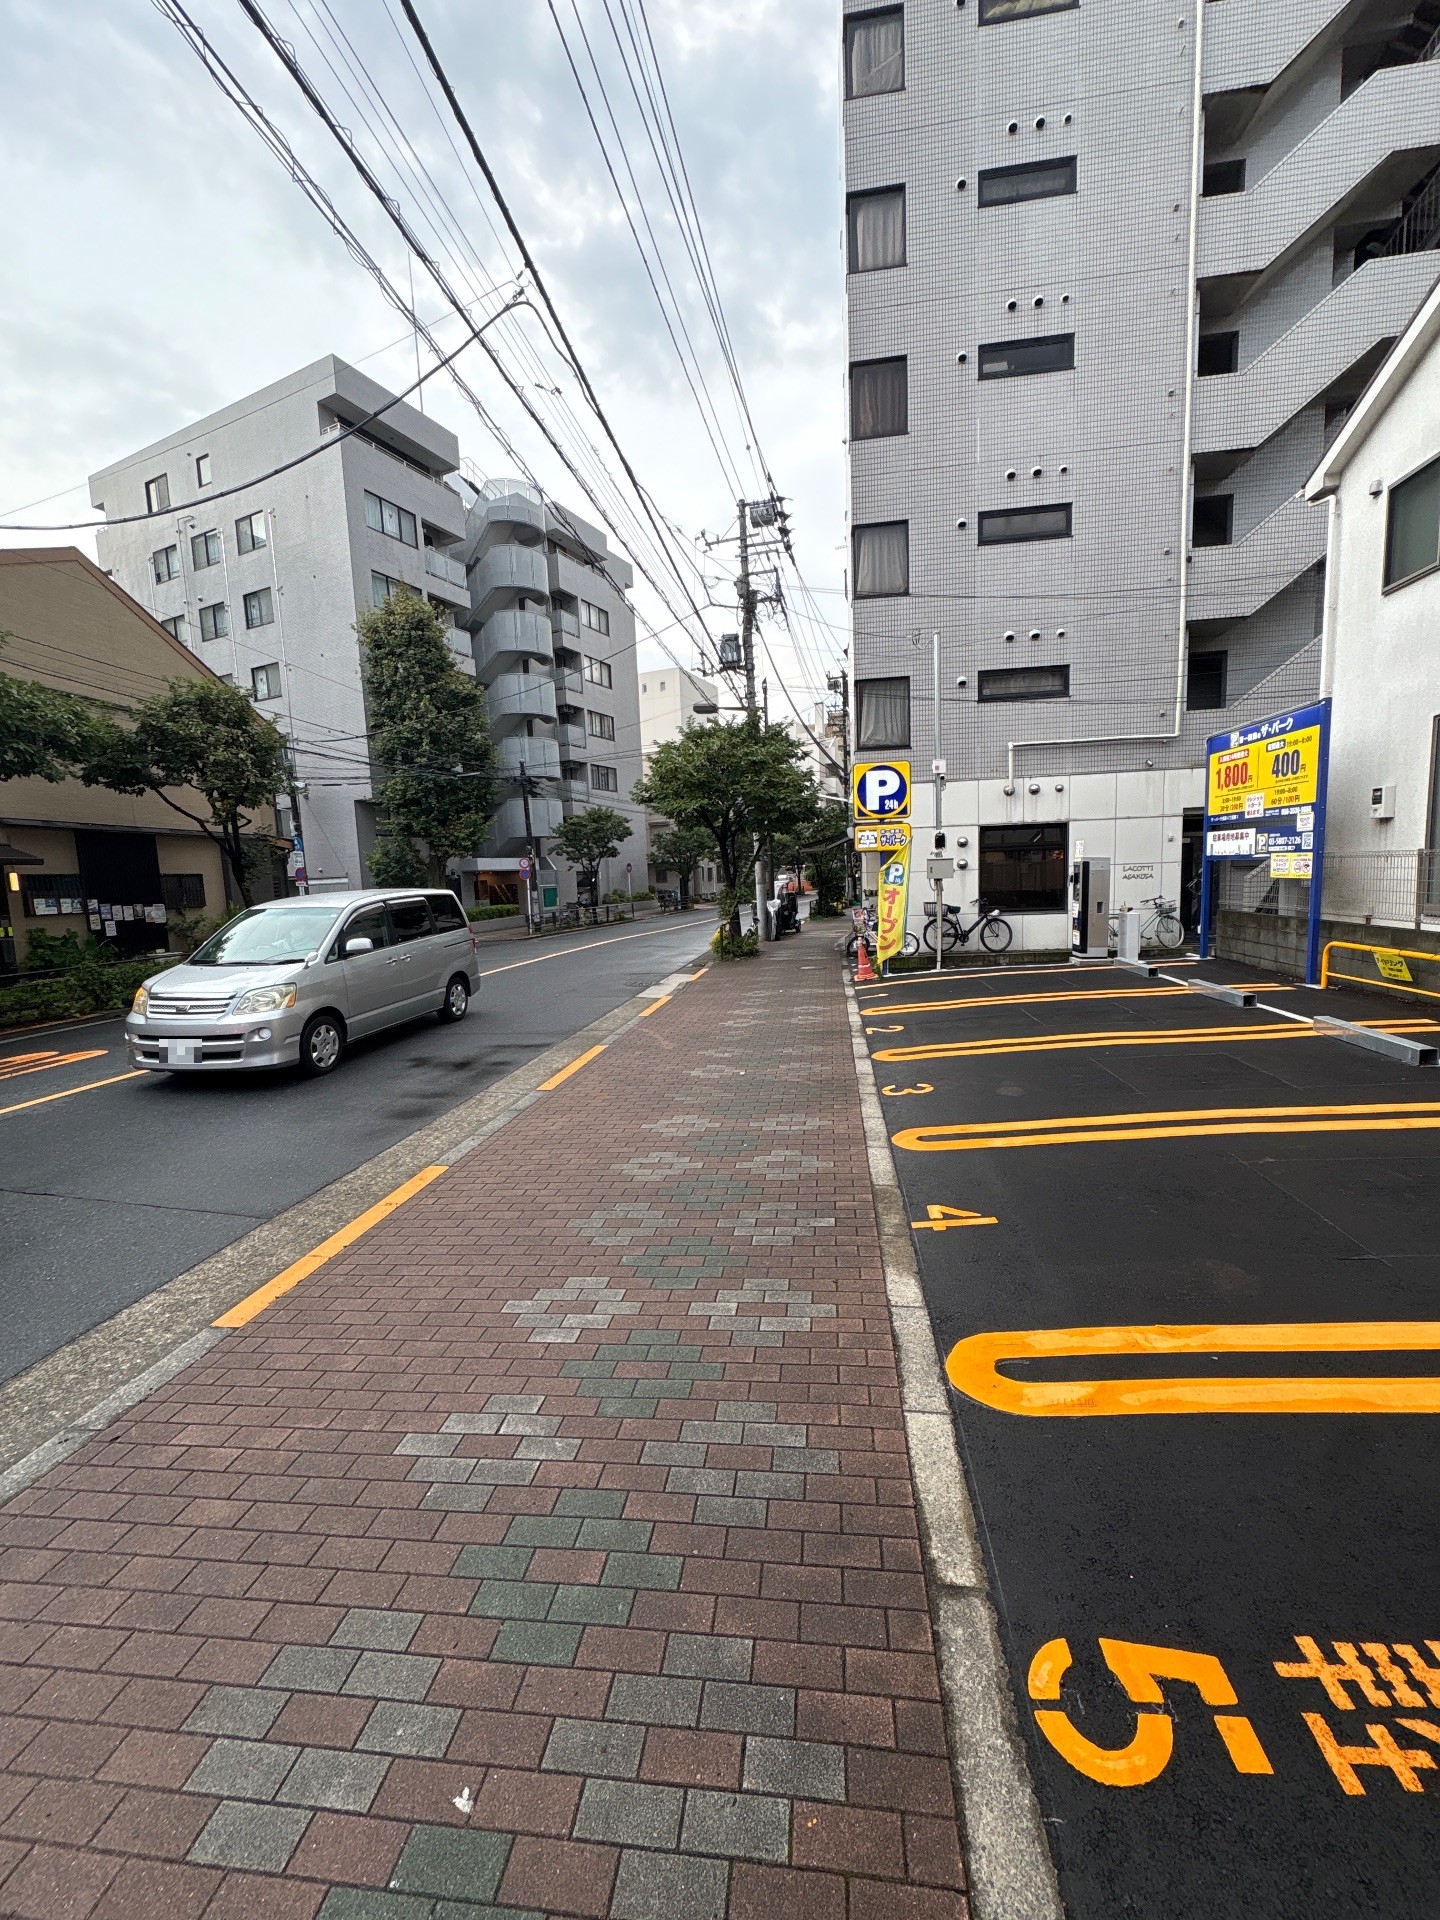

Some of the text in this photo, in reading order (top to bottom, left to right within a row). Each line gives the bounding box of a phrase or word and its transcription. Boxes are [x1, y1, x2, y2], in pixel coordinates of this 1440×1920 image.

[866, 770, 900, 811] P
[884, 799, 899, 810] 24h
[879, 888, 901, 951] オープン
[881, 1083, 935, 1096] 3
[910, 1204, 999, 1231] 4
[1027, 1637, 1274, 1788] 5
